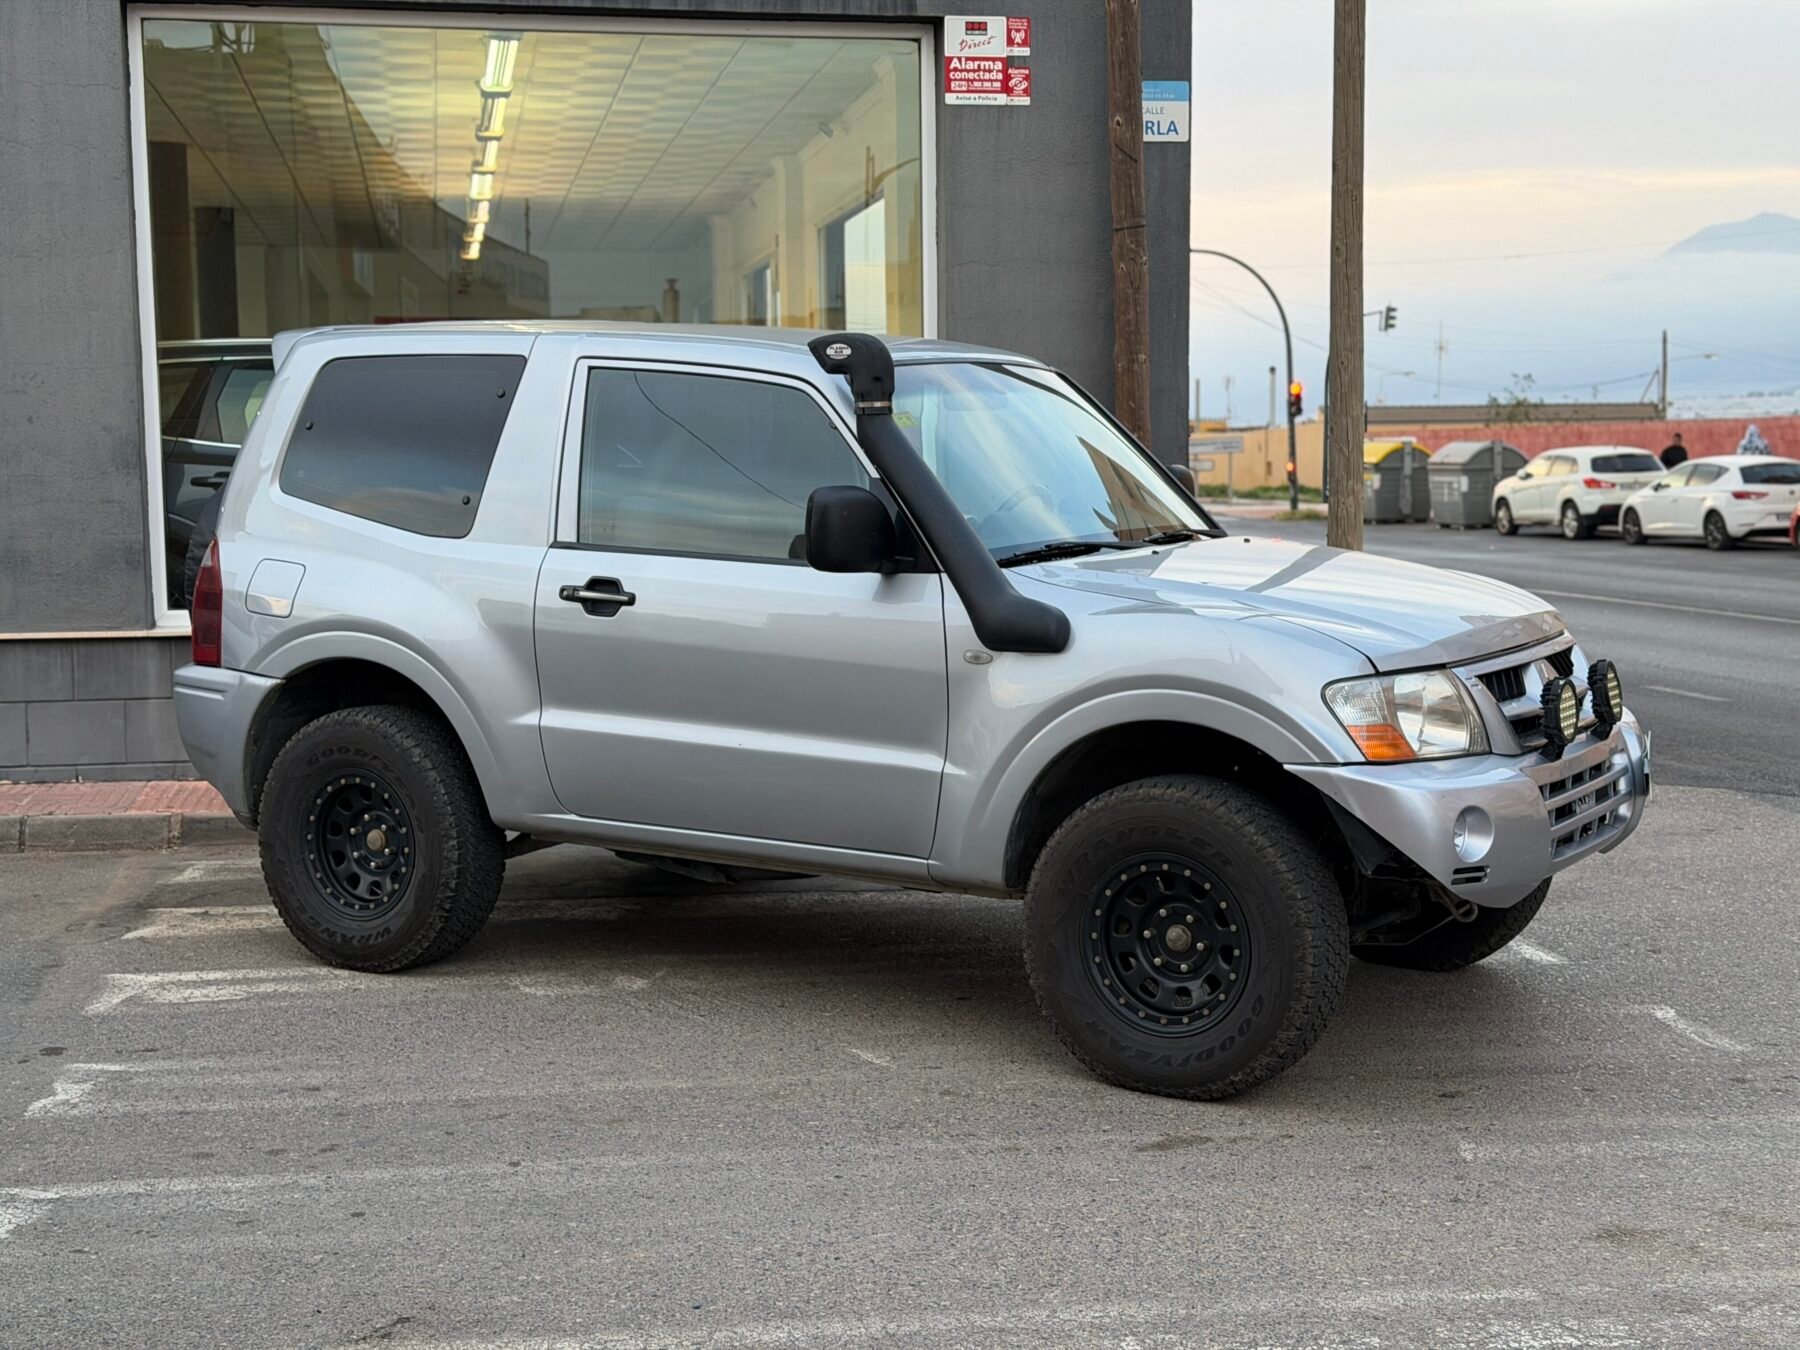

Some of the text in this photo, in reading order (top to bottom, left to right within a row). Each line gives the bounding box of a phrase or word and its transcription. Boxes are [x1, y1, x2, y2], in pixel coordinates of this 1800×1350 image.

[959, 35, 997, 52] Direct
[949, 57, 1003, 70] Alarma
[949, 70, 1003, 80] conectada
[1007, 67, 1029, 75] Alarma
[1142, 106, 1165, 115] ALLE
[1144, 120, 1179, 136] RLA
